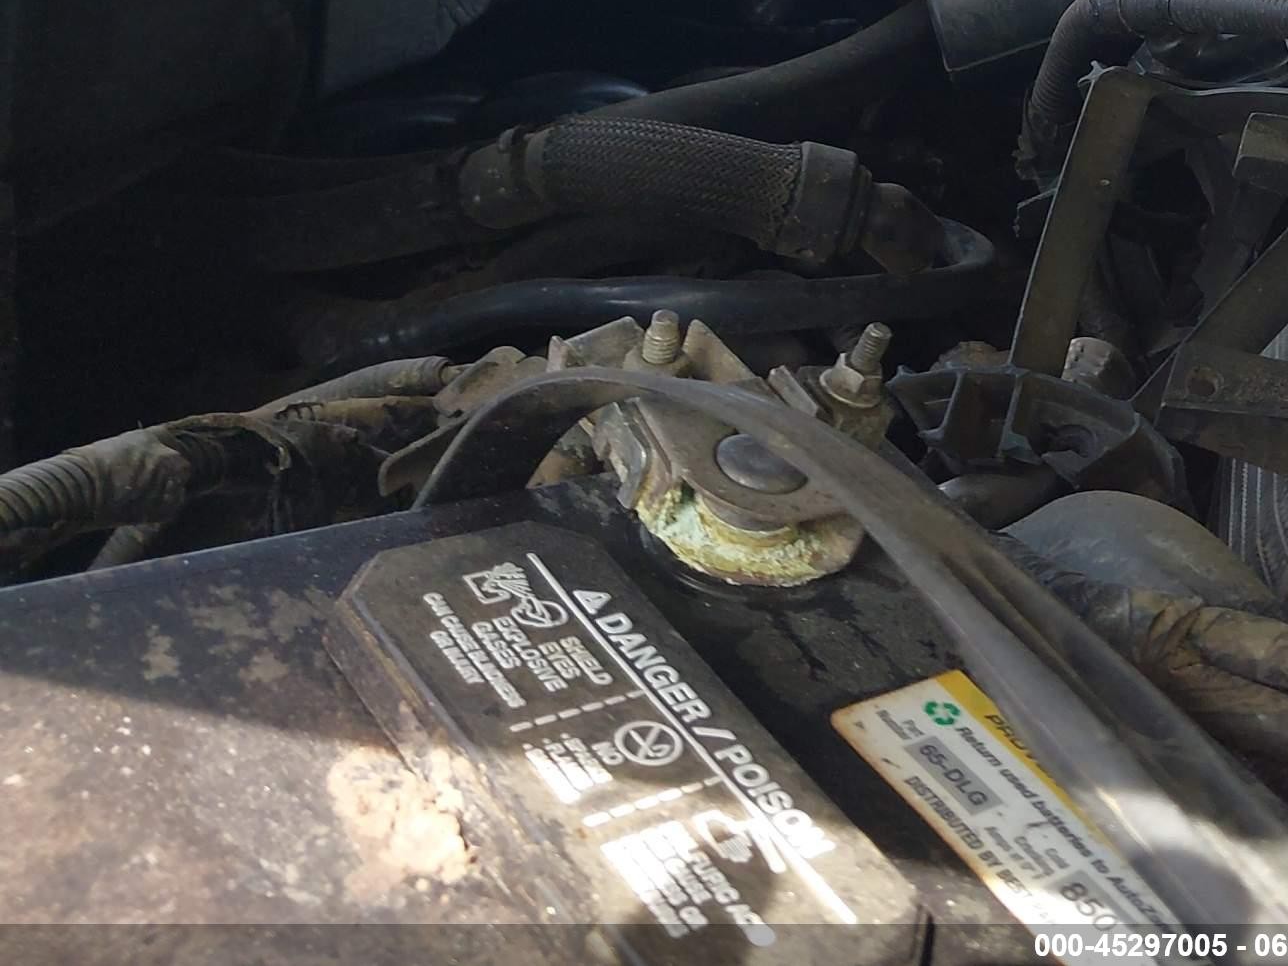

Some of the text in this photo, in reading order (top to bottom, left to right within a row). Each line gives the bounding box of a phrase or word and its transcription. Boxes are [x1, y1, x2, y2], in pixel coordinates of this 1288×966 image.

[422, 592, 454, 617] CAN
[440, 615, 480, 651] CAUSE
[430, 630, 454, 650] OR
[471, 621, 522, 670] GASES
[491, 615, 569, 693] EXPLOSIVE
[538, 640, 581, 680] EYES
[559, 635, 614, 686] SHIELD
[595, 612, 711, 724] DANGER
[590, 741, 625, 766] NO
[919, 743, 988, 807] 65-DLG
[904, 774, 984, 851] DISTRIBUTED
[978, 850, 1005, 868] BY
[954, 726, 1003, 768] Return
[999, 768, 1039, 799] used
[1031, 800, 1095, 858] batteries
[1090, 858, 1111, 875] to
[1060, 881, 1119, 932] 850
